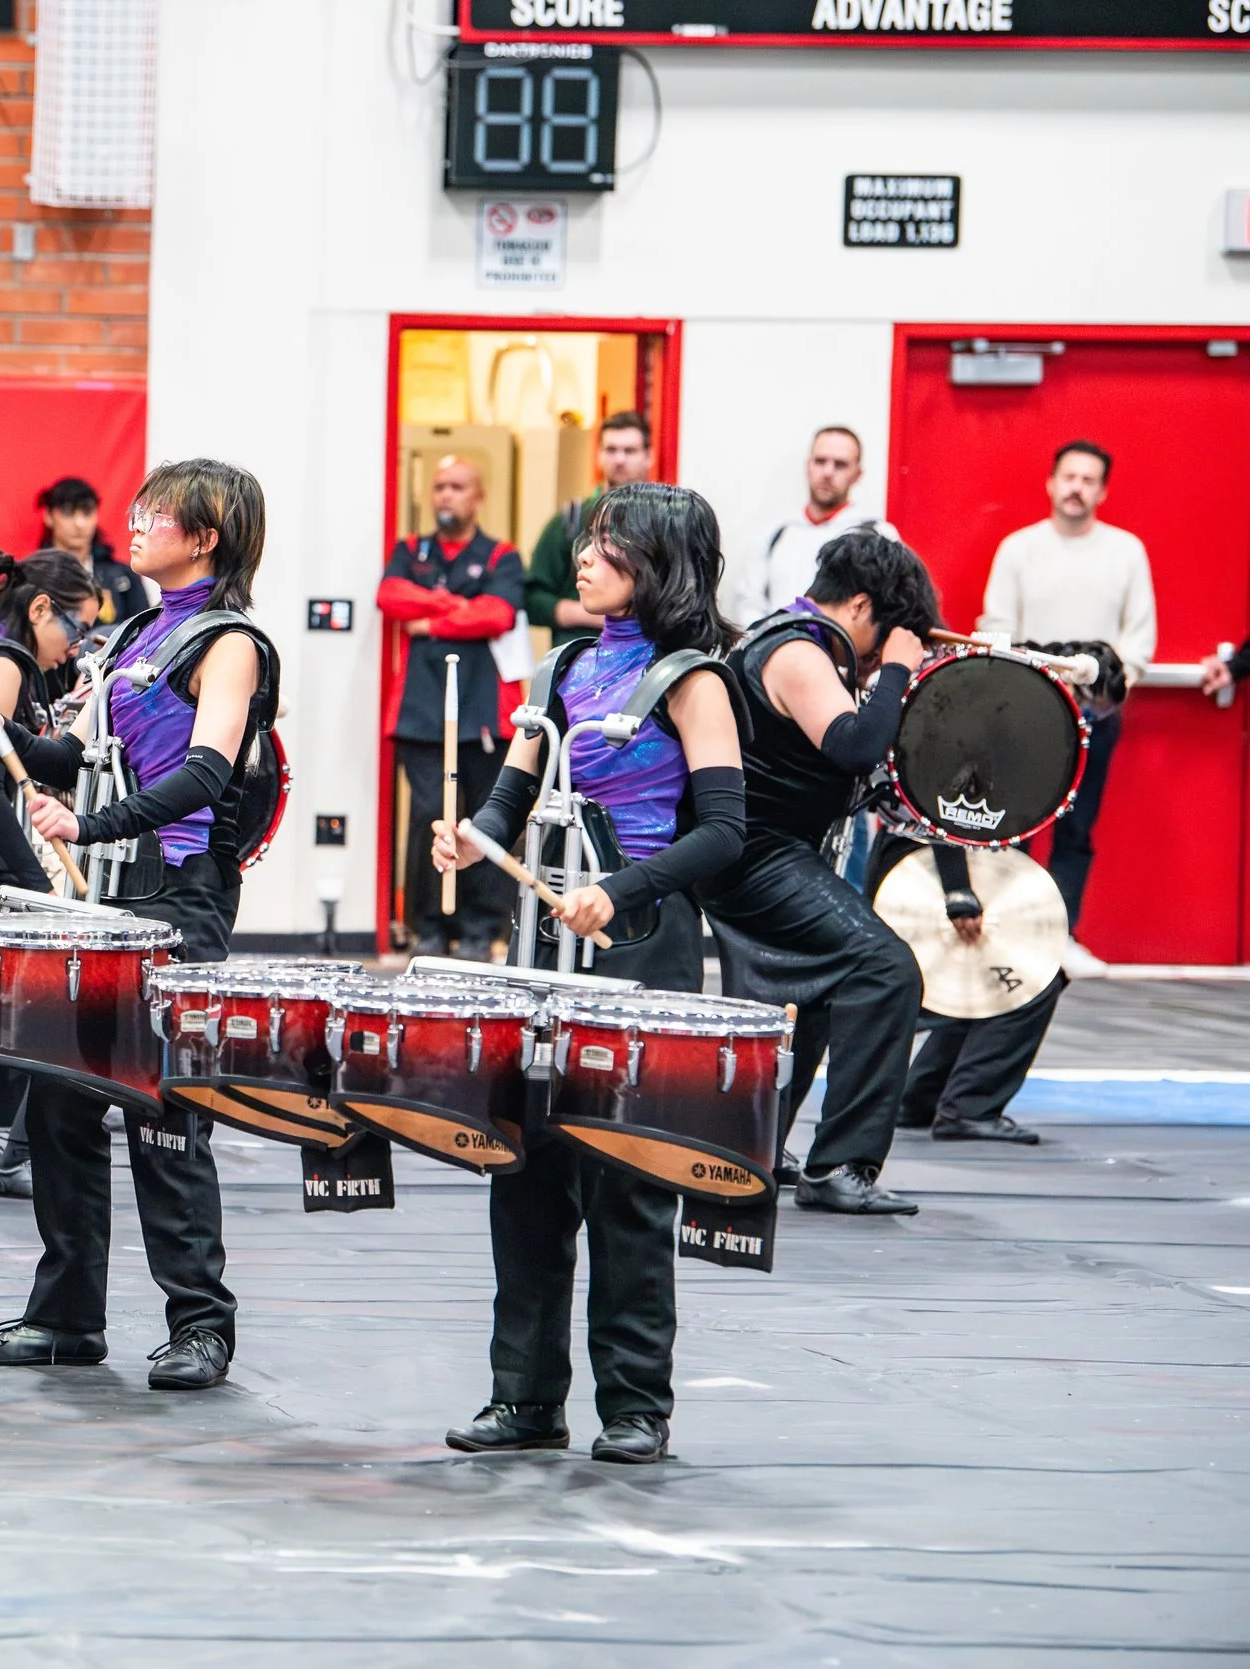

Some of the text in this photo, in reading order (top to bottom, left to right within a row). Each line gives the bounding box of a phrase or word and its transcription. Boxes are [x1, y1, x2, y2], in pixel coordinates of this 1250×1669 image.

[812, 0, 1012, 31] ADVANTAGE
[944, 805, 994, 825] REMO
[140, 1123, 187, 1152] VIC FIRTH
[304, 1174, 381, 1197] VIC FIRTH
[708, 1164, 752, 1186] YAMAHA
[681, 1220, 764, 1256] VIC FIRTH
